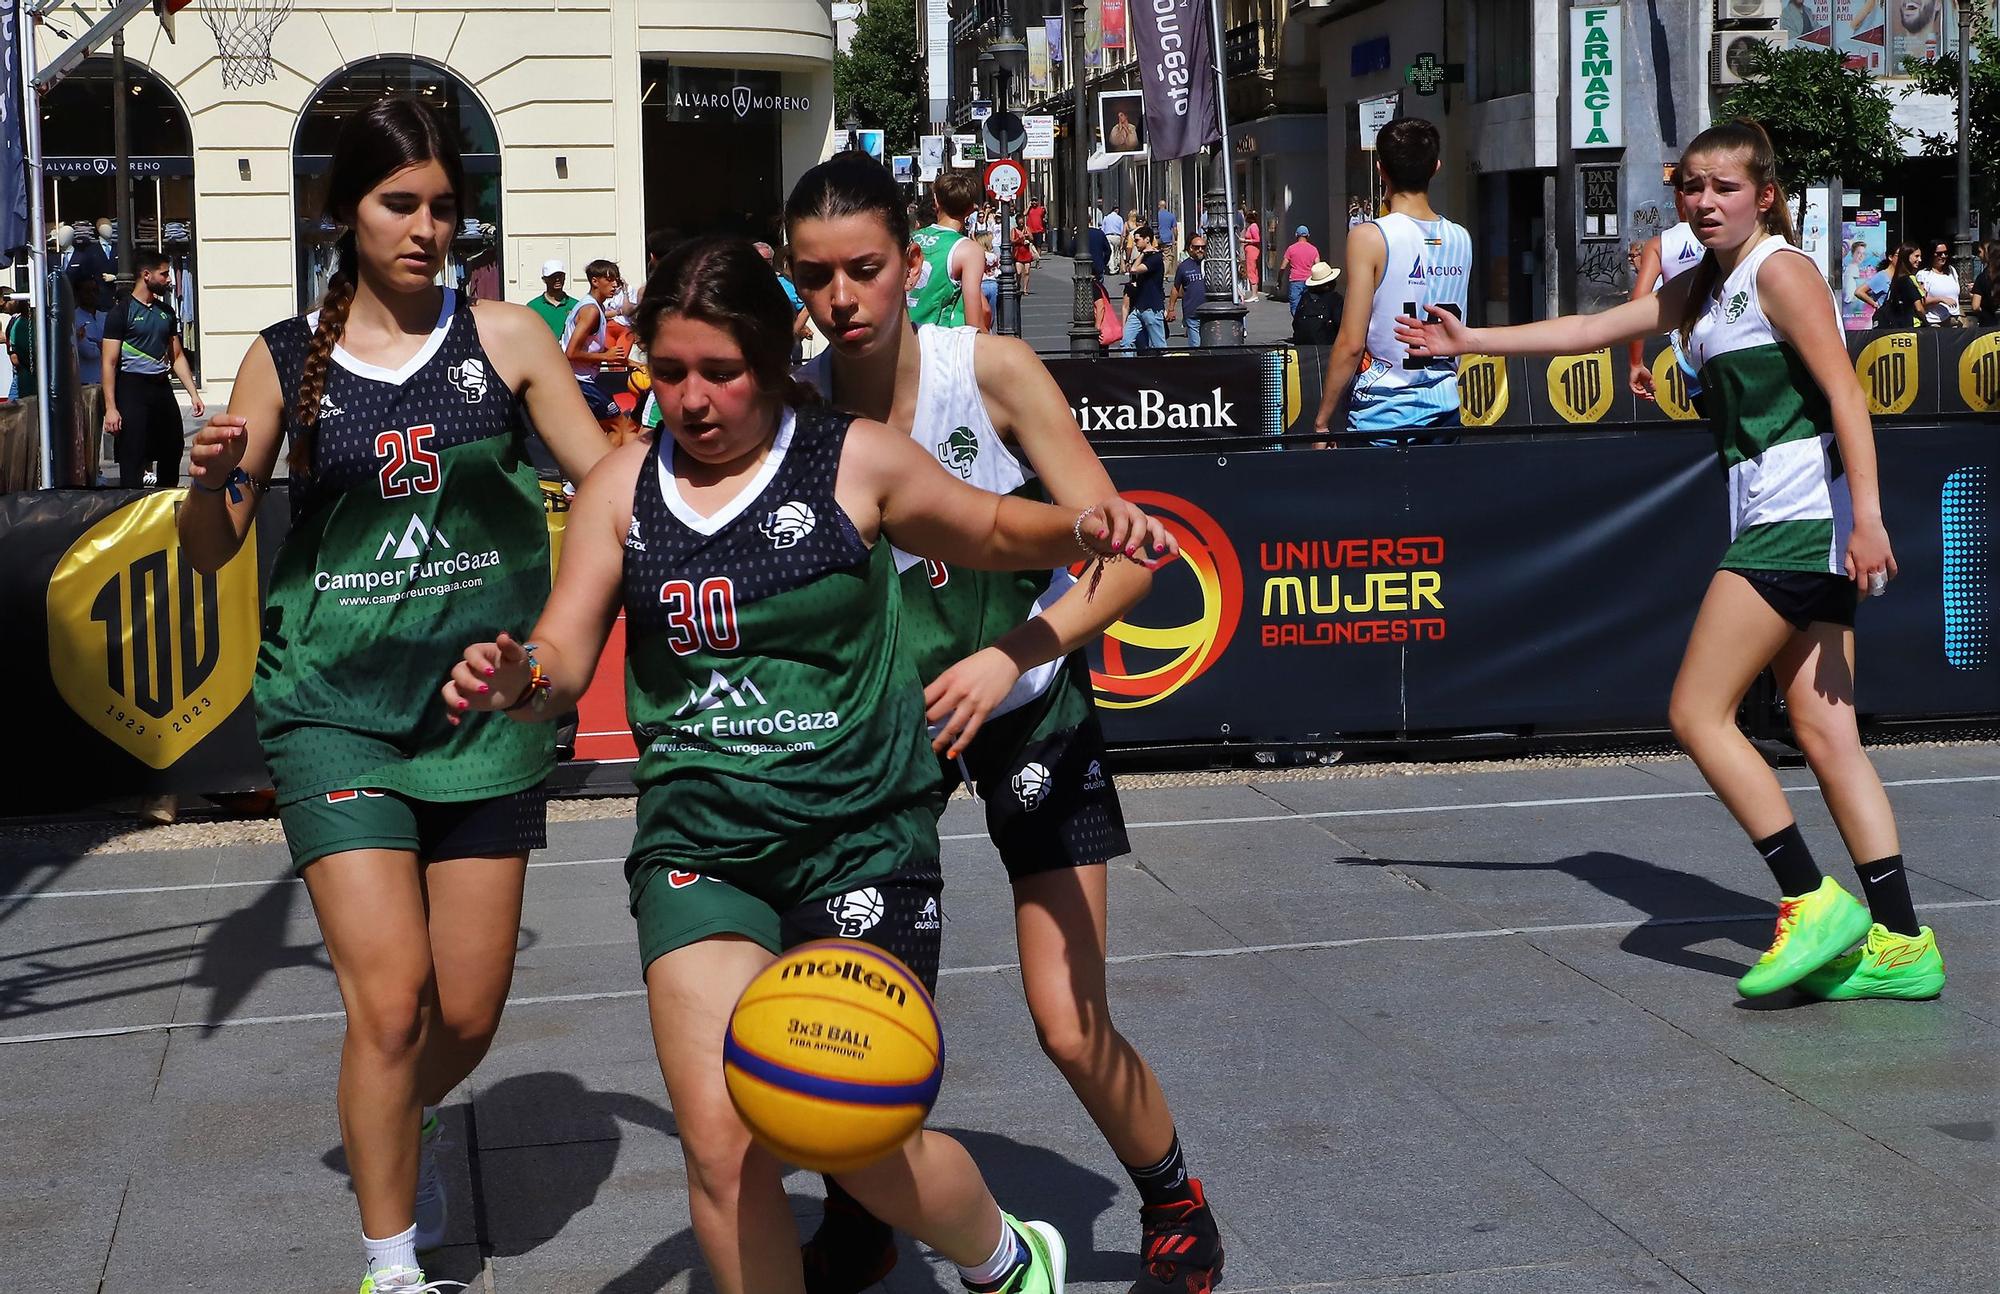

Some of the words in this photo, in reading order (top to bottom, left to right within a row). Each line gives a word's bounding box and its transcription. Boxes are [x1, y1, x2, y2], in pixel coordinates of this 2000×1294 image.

[1582, 10, 1612, 144] FARMACIA
[675, 92, 729, 107] ALVARO
[753, 96, 810, 111] MORENO
[46, 163, 91, 171] ALVARO
[1426, 265, 1463, 277] ACUOS
[1891, 338, 1912, 348] FEB
[375, 424, 441, 499] 25
[1260, 536, 1445, 571] UNIVERSO
[314, 569, 405, 592] Camper
[410, 550, 500, 582] EuroGaza
[1262, 570, 1445, 616] MUJER
[660, 576, 740, 656] 30
[105, 704, 145, 735] 1923
[172, 697, 212, 732] 2023
[711, 709, 839, 738] EuroGaza
[781, 961, 907, 1008] molten
[787, 1018, 823, 1038] 3x3
[827, 1024, 872, 1051] BALL
[813, 1041, 865, 1061] APPROVED
